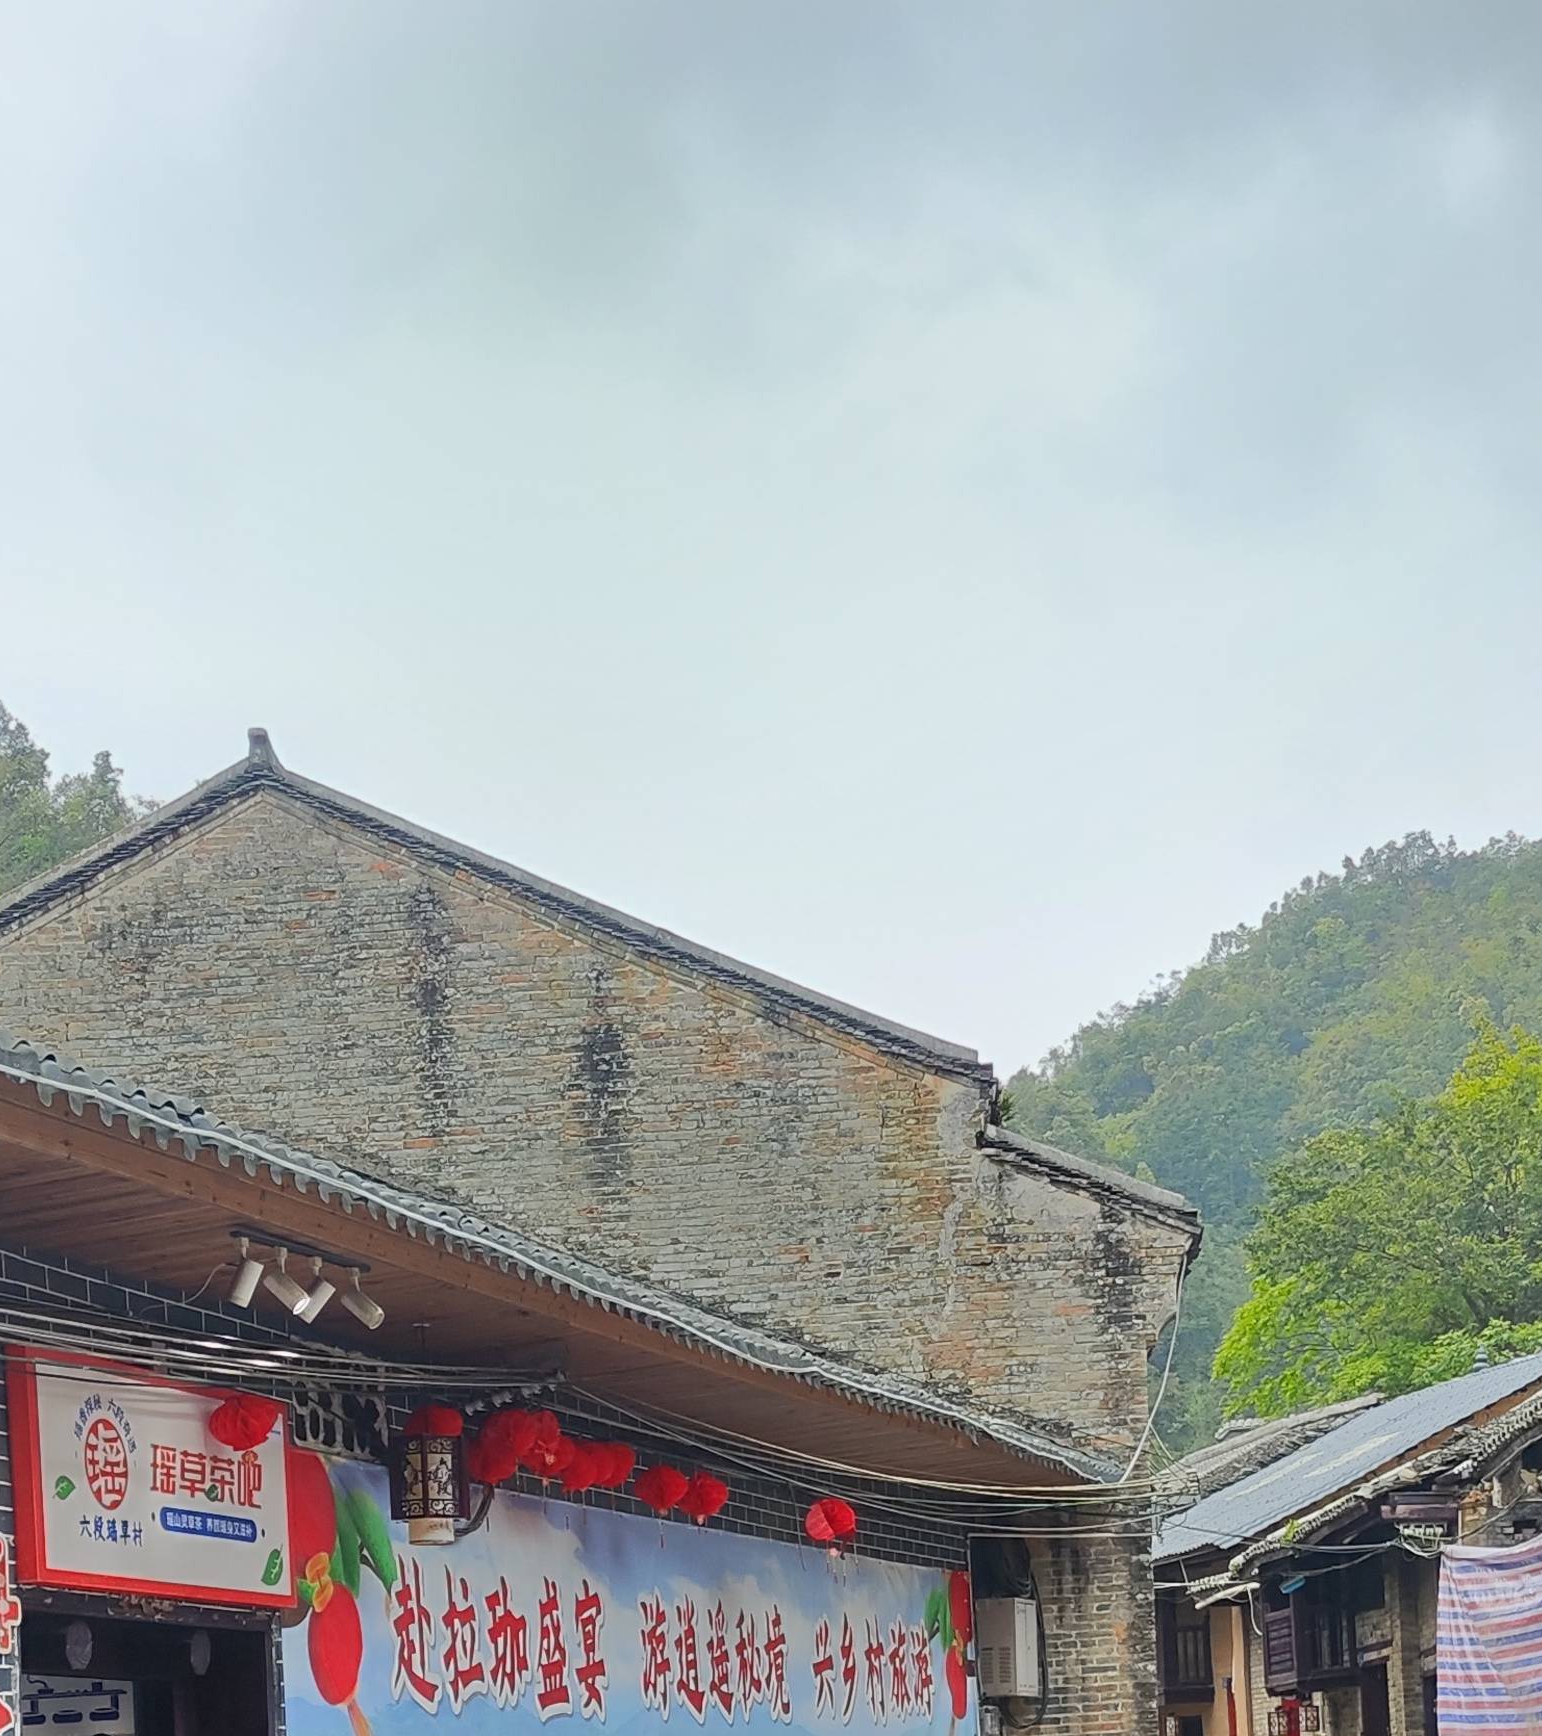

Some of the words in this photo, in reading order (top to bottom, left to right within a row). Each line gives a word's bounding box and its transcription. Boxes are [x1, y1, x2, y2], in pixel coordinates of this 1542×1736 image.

[391, 1552, 607, 1714] 赴拉珈盛宴
[638, 1593, 793, 1717] 游逍遥秘境
[811, 1611, 934, 1718] 兴乡村旅游
